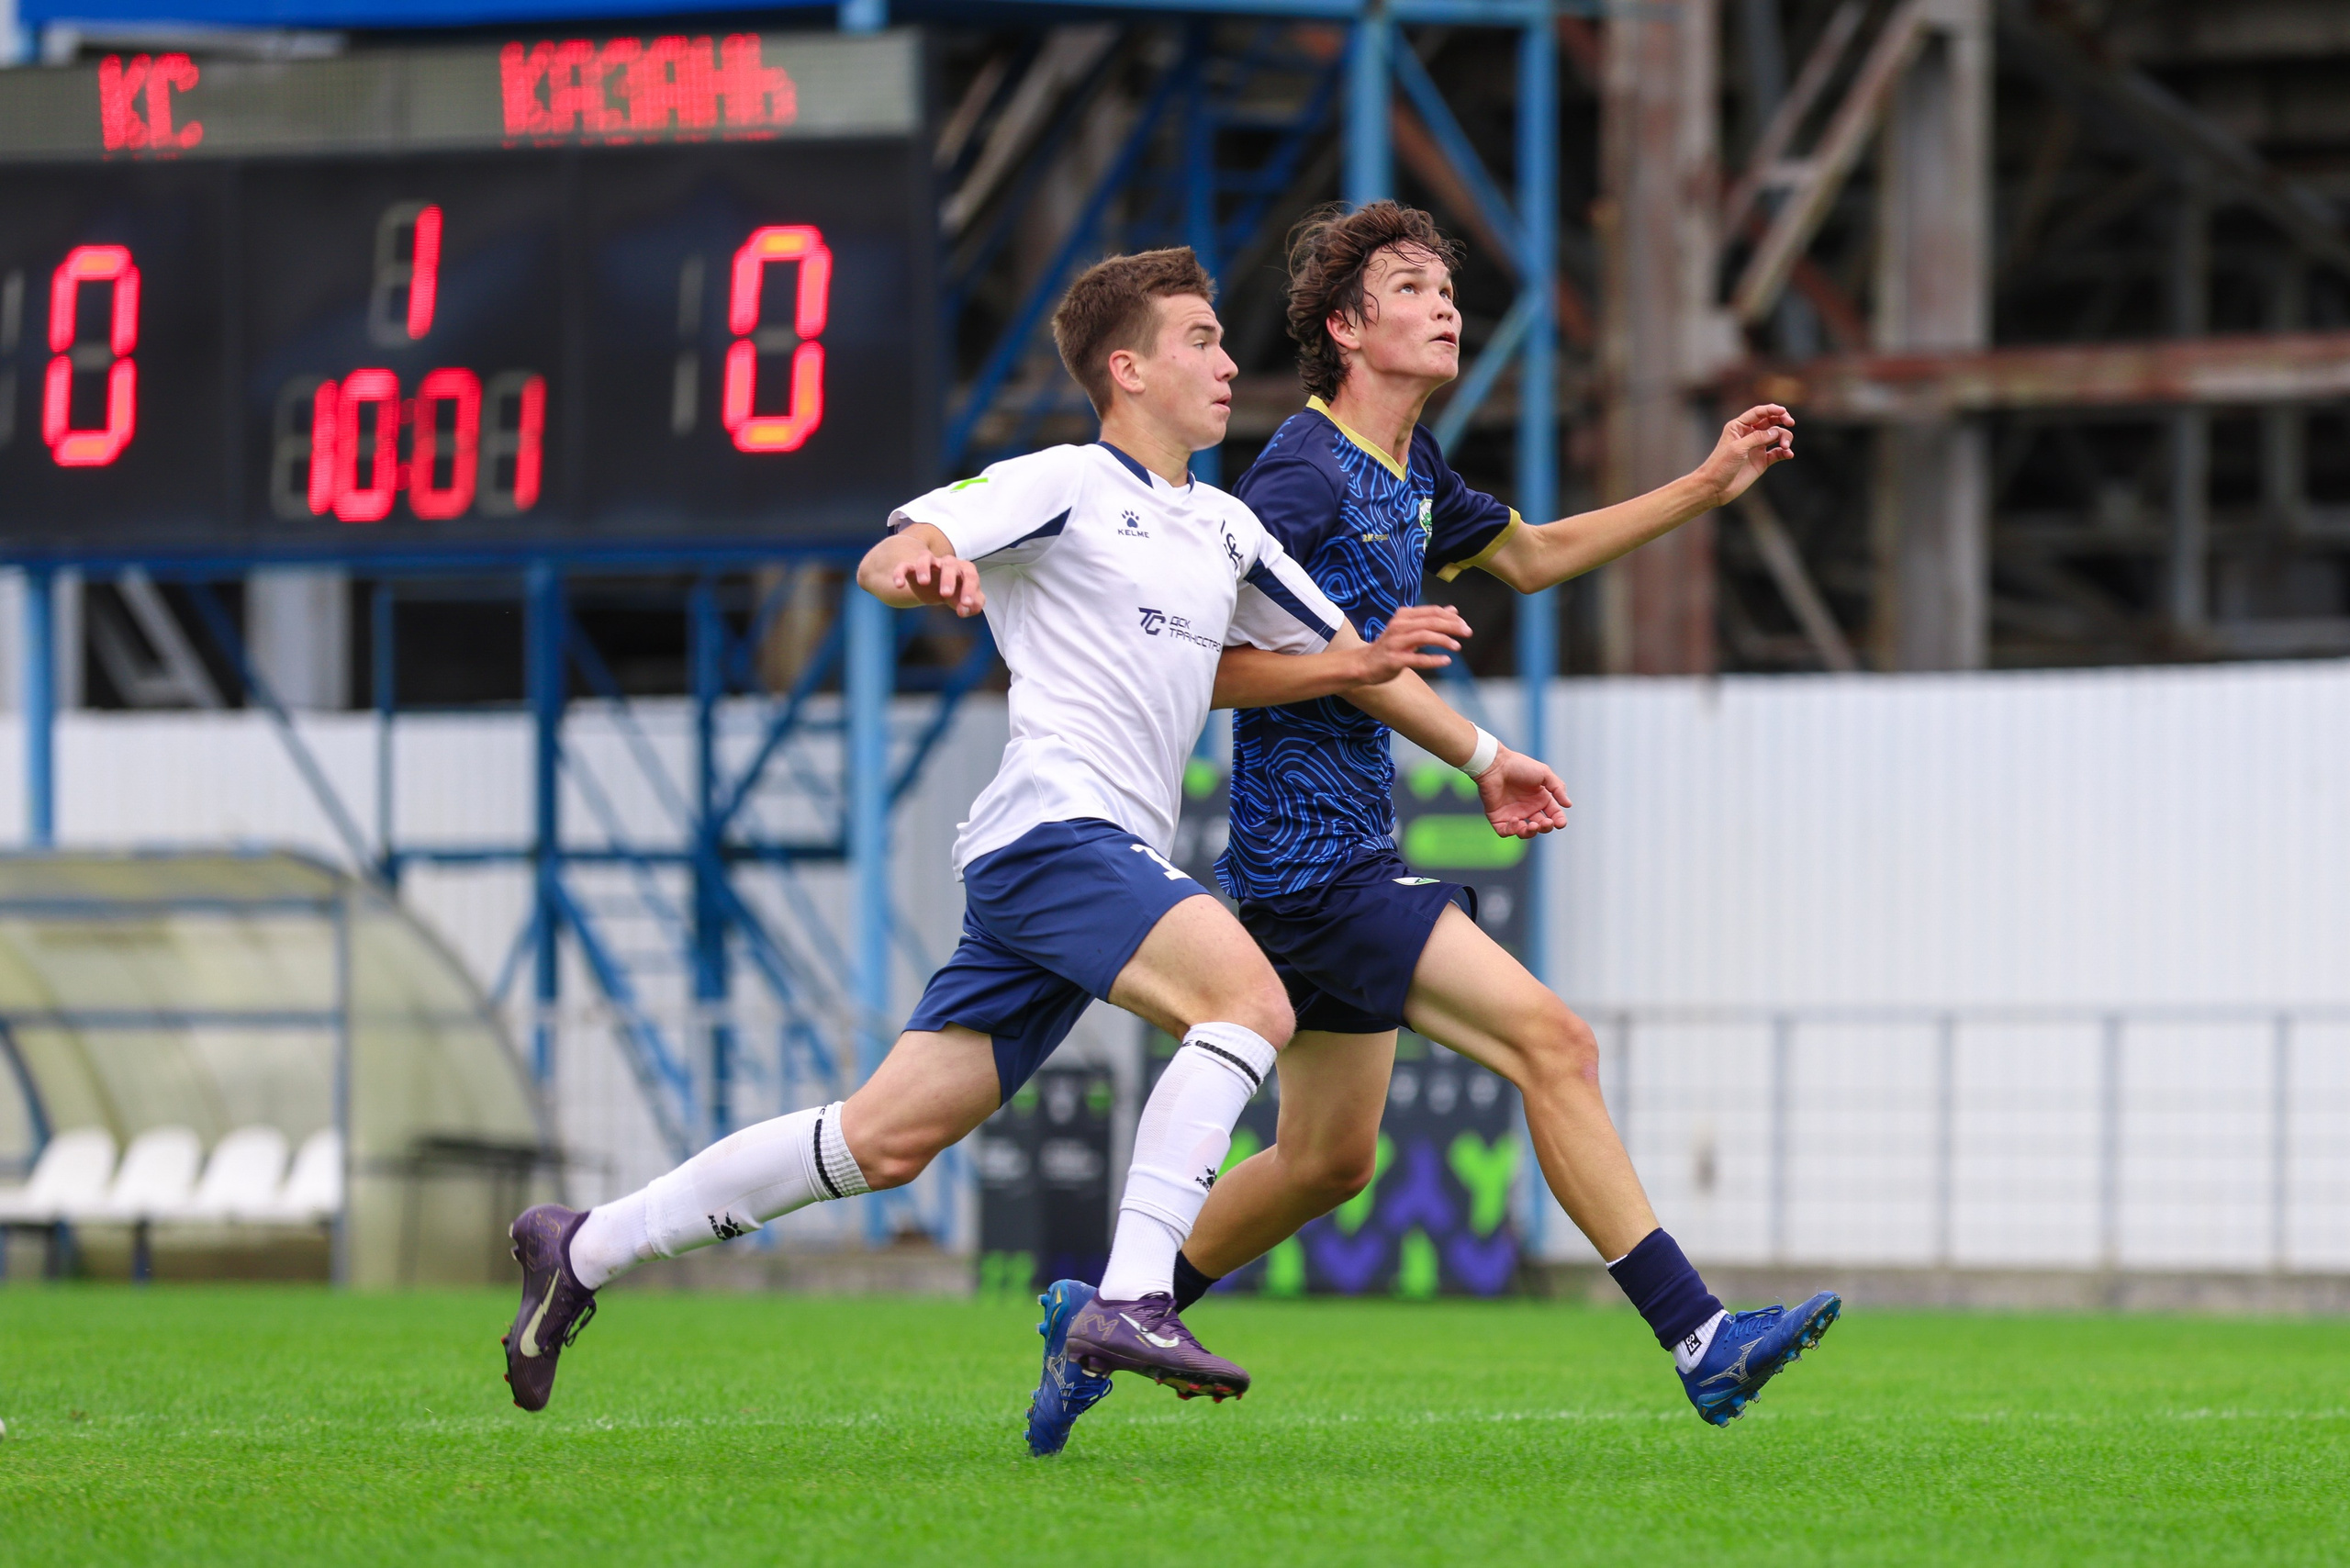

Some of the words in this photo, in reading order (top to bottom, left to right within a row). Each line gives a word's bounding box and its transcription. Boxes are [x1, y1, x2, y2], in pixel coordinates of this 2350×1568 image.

[99, 52, 204, 154] КС
[500, 34, 797, 144] КАЗАНЬ
[407, 206, 442, 340] 1
[42, 244, 141, 466] 0
[722, 224, 833, 453] 0
[1117, 529, 1150, 538] KELME
